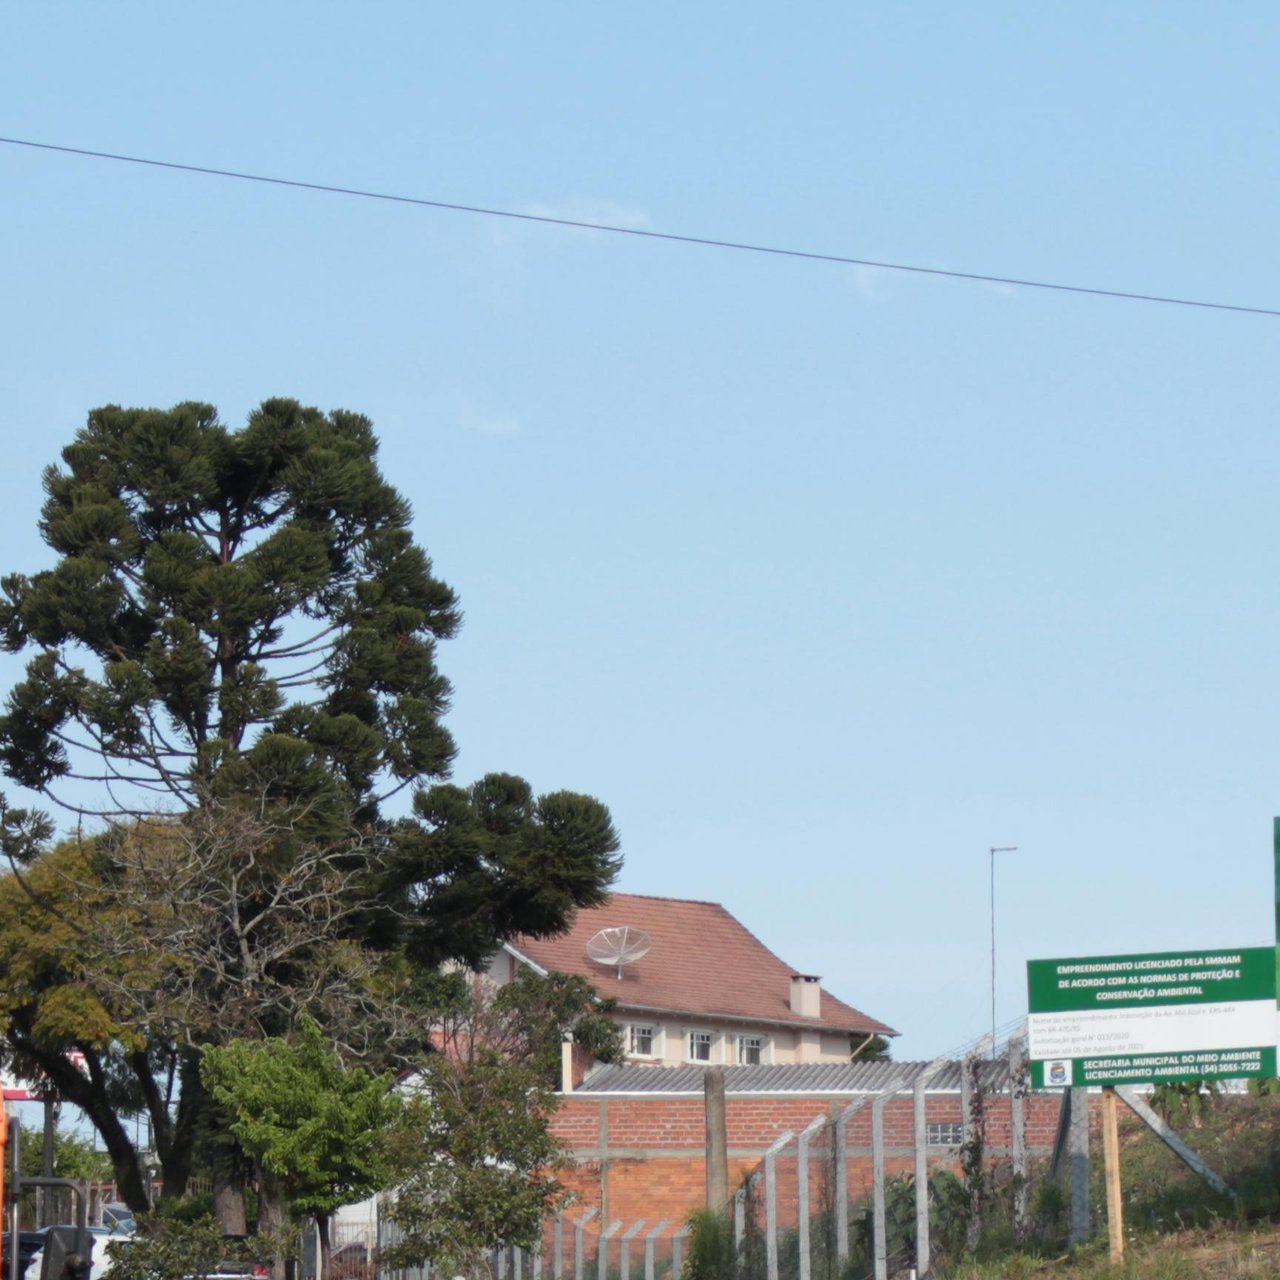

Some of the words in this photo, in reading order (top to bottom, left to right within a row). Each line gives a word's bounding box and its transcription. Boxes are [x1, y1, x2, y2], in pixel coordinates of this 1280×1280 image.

[1057, 961, 1133, 974] EMPREENDIMENTO
[1134, 958, 1182, 970] LICENCIADO
[1184, 957, 1203, 967] PELA
[1058, 979, 1070, 988] DE
[1071, 977, 1106, 987] ACORDO
[1107, 976, 1127, 985] COM
[1128, 975, 1139, 984] AS
[1140, 973, 1177, 983] NORMAS
[1178, 972, 1189, 981] DE
[1190, 968, 1234, 980] PROTEÇÃO
[1235, 969, 1241, 978] E
[1096, 987, 1156, 1000] CONSERVAÇÃO
[1156, 986, 1203, 997] AMBIENTAL
[1083, 1059, 1131, 1069] SECRETARIA
[1132, 1055, 1178, 1068] MUNICIPAL
[1181, 1054, 1194, 1064] DO
[1197, 1053, 1218, 1063] MEIO
[1220, 1051, 1260, 1061] AMBIENTE
[1085, 1068, 1152, 1080] LICENCIAMENTO
[1154, 1065, 1199, 1076] AMBIENTAL
[1201, 1064, 1218, 1075] (54)
